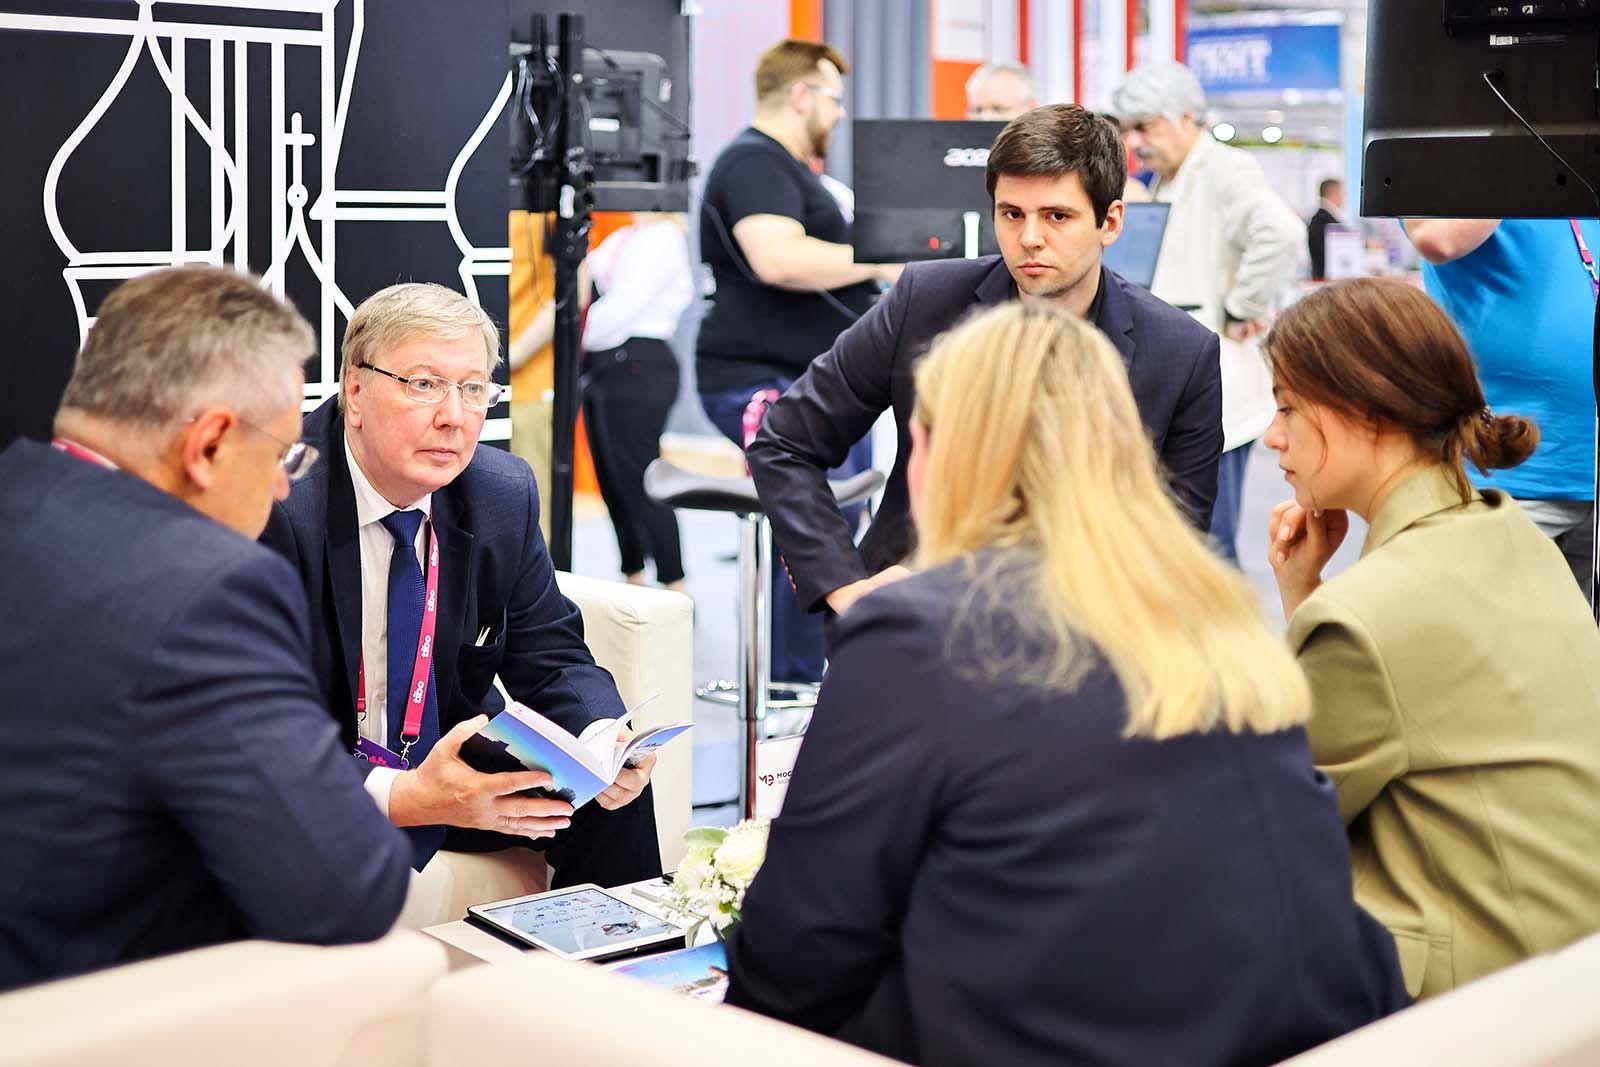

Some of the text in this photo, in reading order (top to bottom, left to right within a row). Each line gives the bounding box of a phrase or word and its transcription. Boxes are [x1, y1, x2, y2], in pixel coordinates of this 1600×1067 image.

[943, 147, 991, 167] ace
[427, 589, 436, 612] tibo
[420, 634, 431, 658] tibo
[412, 680, 424, 704] tibo
[776, 770, 792, 779] МОС
